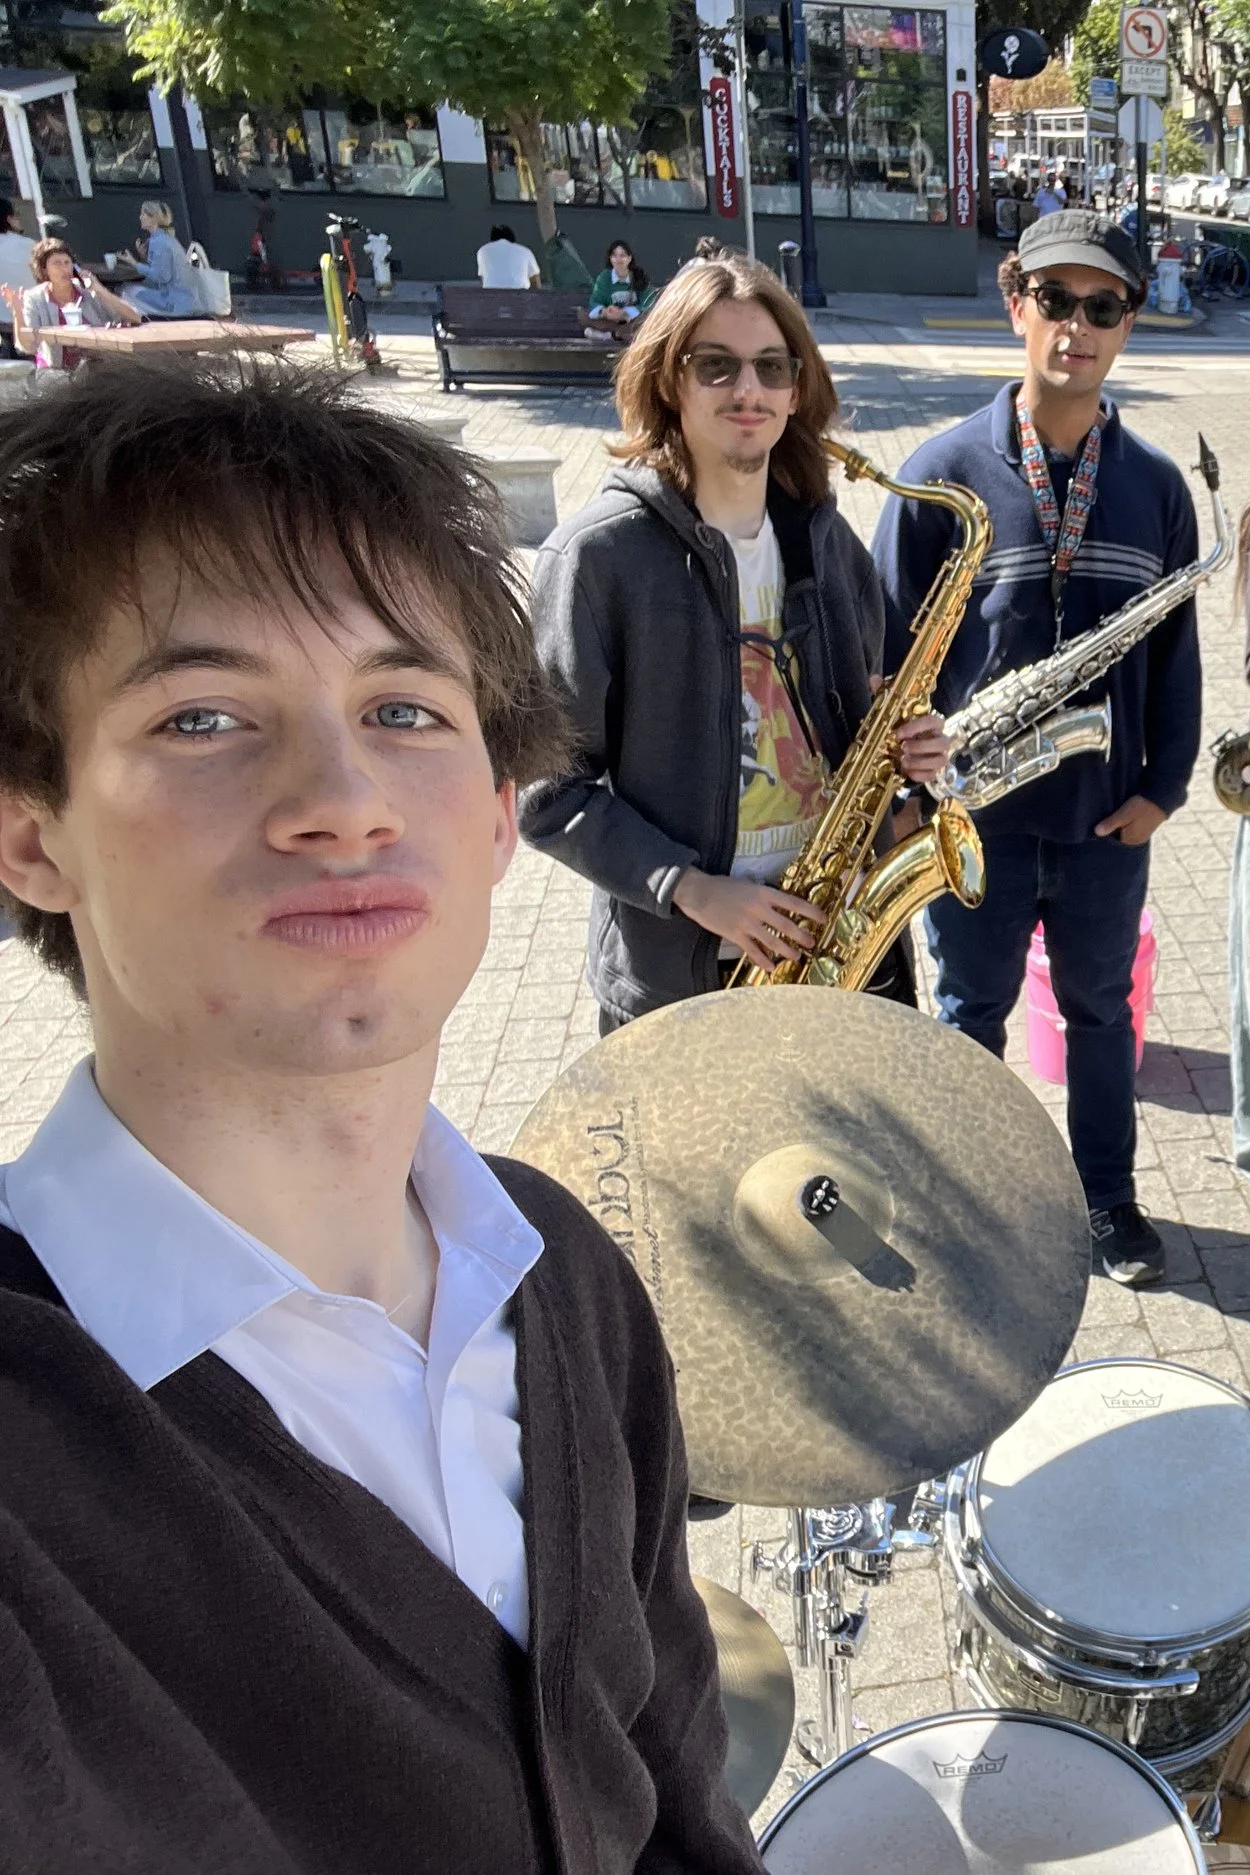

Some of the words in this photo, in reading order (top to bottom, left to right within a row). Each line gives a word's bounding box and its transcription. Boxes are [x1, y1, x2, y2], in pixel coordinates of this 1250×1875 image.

[1128, 65, 1161, 76] EXCEPT
[714, 87, 733, 209] COCKTAILS
[956, 94, 970, 225] RESTAURANT
[943, 1762, 997, 1775] REMO
